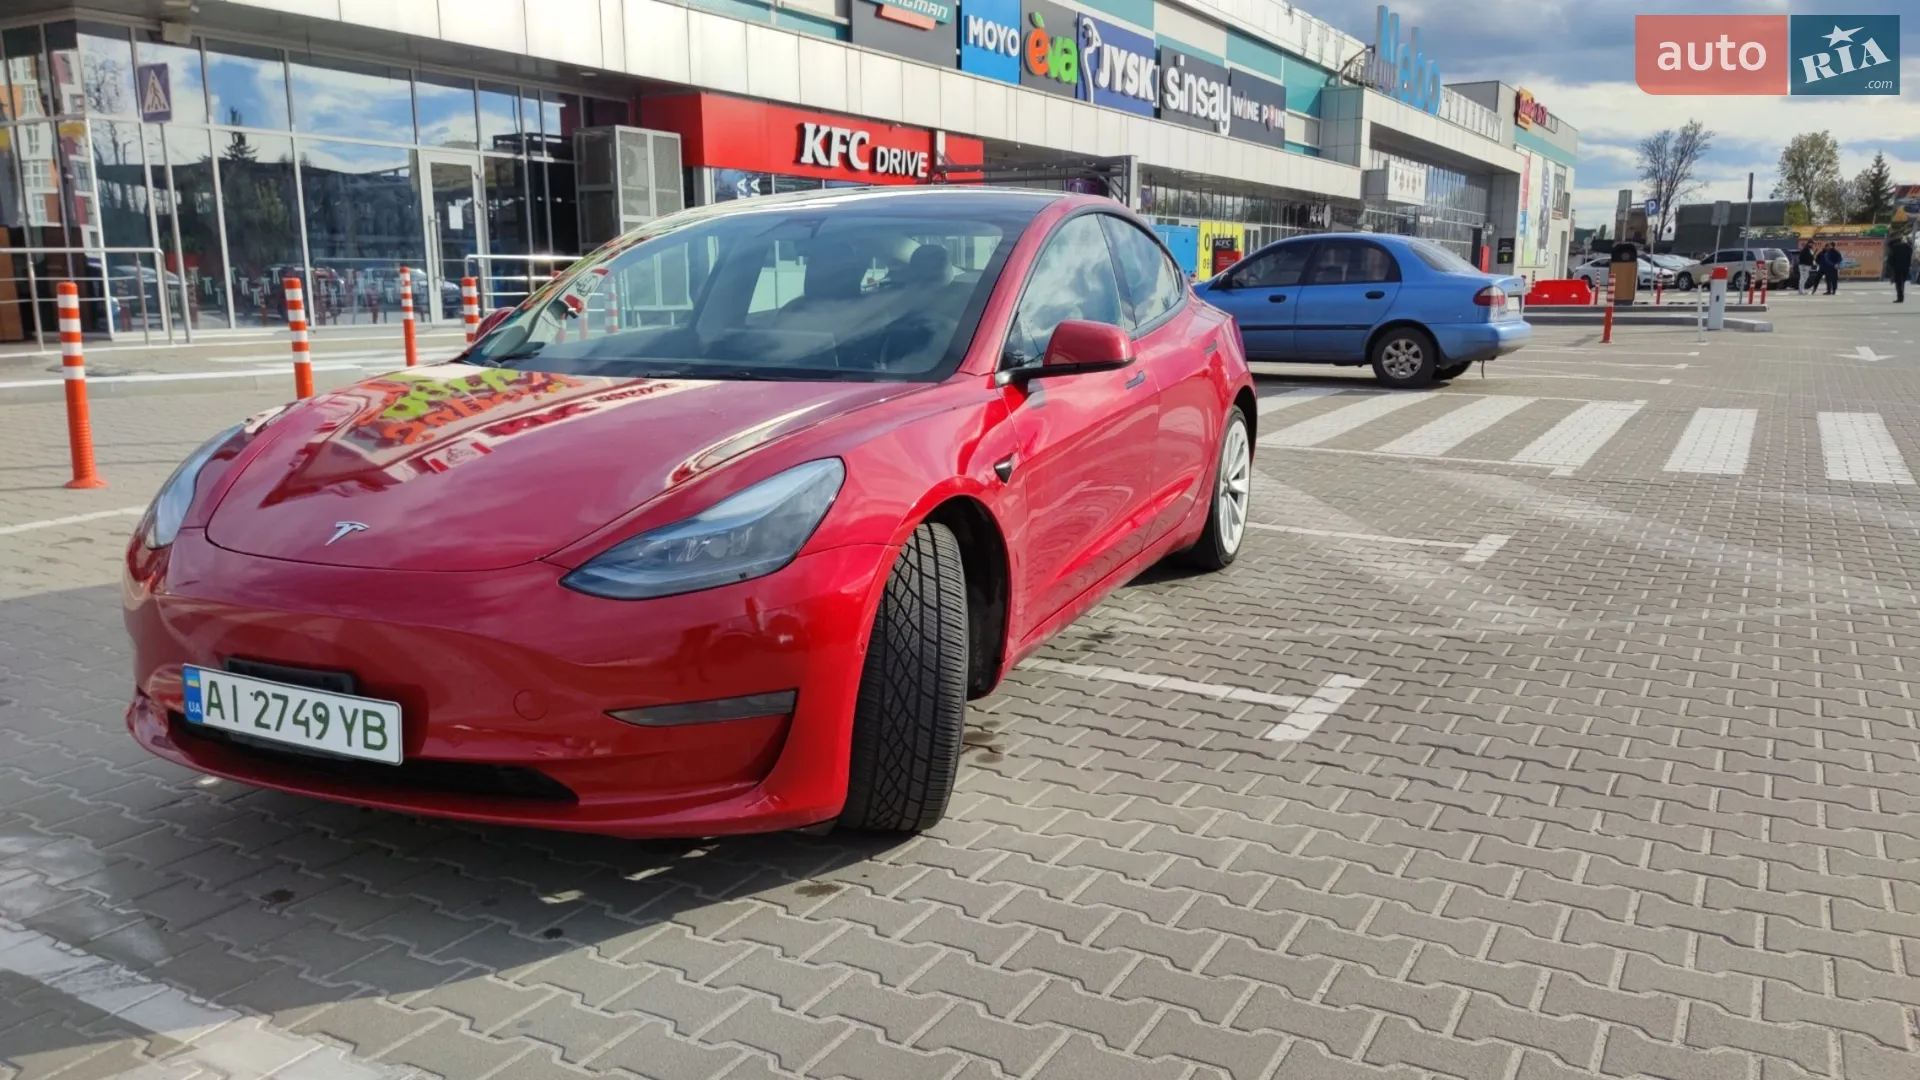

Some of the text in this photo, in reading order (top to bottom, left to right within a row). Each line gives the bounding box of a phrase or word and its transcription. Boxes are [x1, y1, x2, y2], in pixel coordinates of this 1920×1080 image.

[969, 15, 1020, 57] MOYO
[1096, 44, 1155, 100] JYSK
[1166, 55, 1230, 136] sinsay
[1232, 94, 1259, 122] WINE
[801, 122, 928, 178] KFC DRIVE
[188, 701, 201, 714] UA
[206, 680, 388, 751] AI 2749 YB
